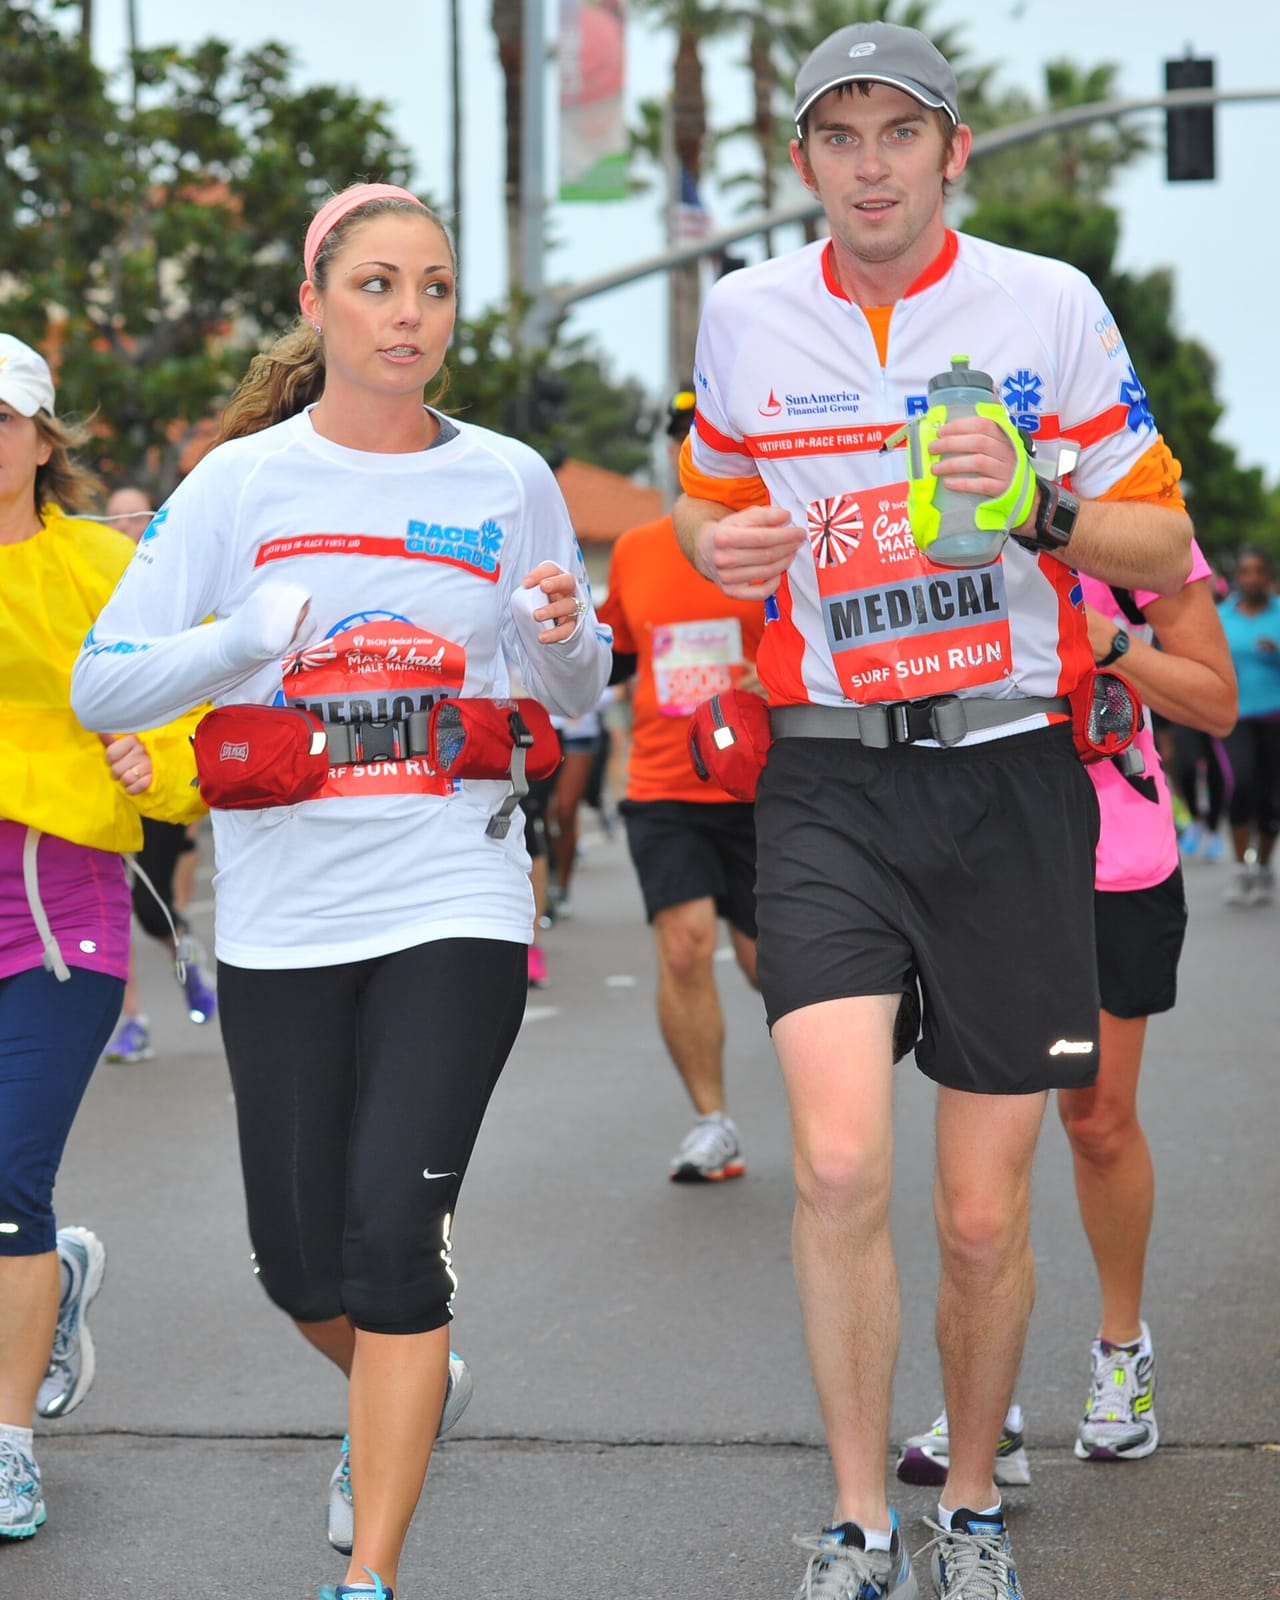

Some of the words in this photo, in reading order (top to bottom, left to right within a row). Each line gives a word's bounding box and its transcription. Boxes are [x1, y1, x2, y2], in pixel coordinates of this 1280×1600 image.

[785, 391, 860, 406] SunAmerica
[788, 405, 828, 416] Financial
[830, 403, 859, 414] Group
[795, 435, 834, 448] IN-RACE
[837, 433, 865, 445] FIRST
[867, 431, 882, 441] AID
[407, 520, 480, 546] RACE
[873, 514, 911, 541] Car
[348, 539, 360, 548] AID
[878, 534, 915, 554] MAR
[406, 538, 496, 572] GUARDS
[889, 548, 916, 563] HALF
[829, 572, 1000, 641] MEDICAL
[388, 637, 412, 646] Medical
[413, 636, 434, 645] Center
[358, 663, 384, 673] HALF
[851, 667, 890, 688] SURF
[895, 655, 941, 679] SUN
[947, 641, 1001, 670] RUN
[352, 762, 398, 777] SUN
